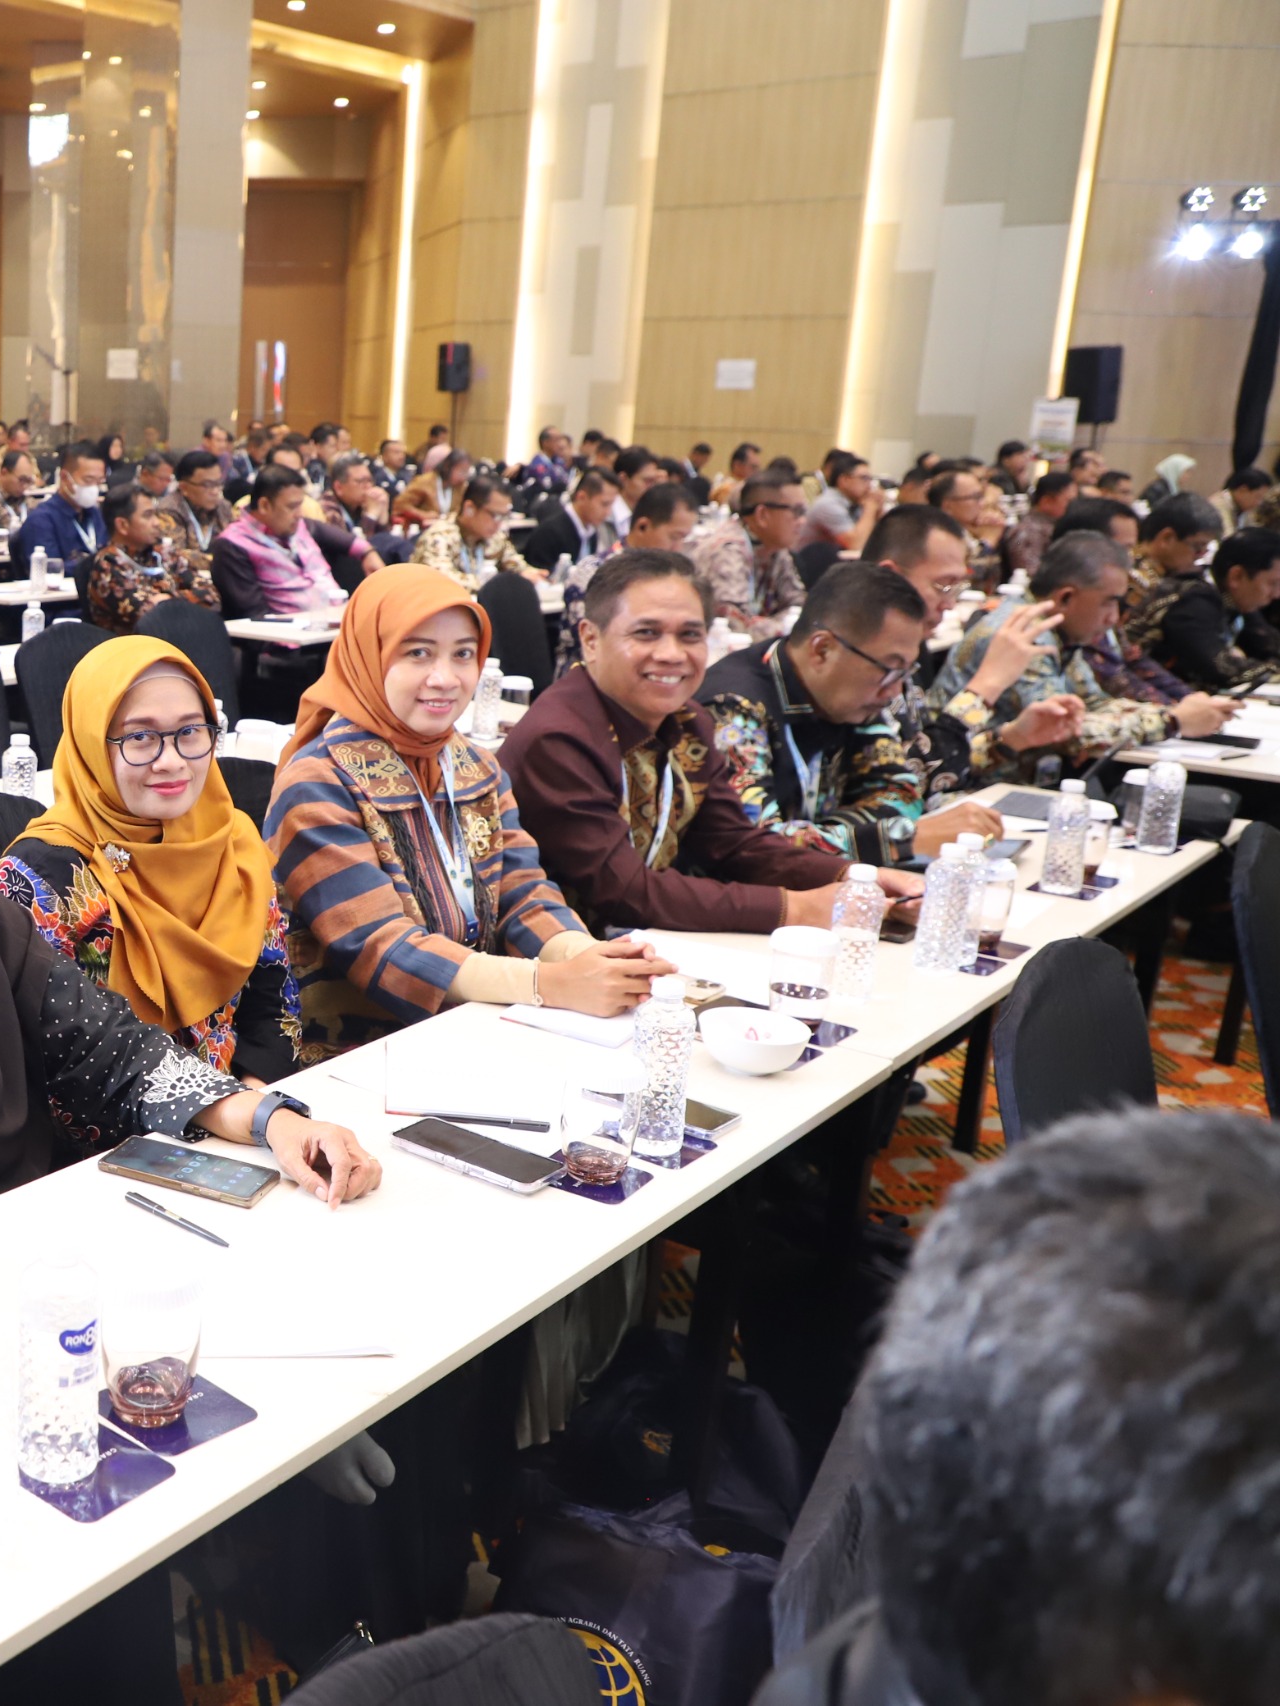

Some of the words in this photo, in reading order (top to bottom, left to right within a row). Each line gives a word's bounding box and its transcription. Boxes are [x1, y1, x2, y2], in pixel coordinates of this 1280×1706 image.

[568, 1617, 601, 1631] AGRARIA
[602, 1628, 619, 1641] DAN
[618, 1639, 634, 1657] TATA
[634, 1658, 652, 1686] RUANG
